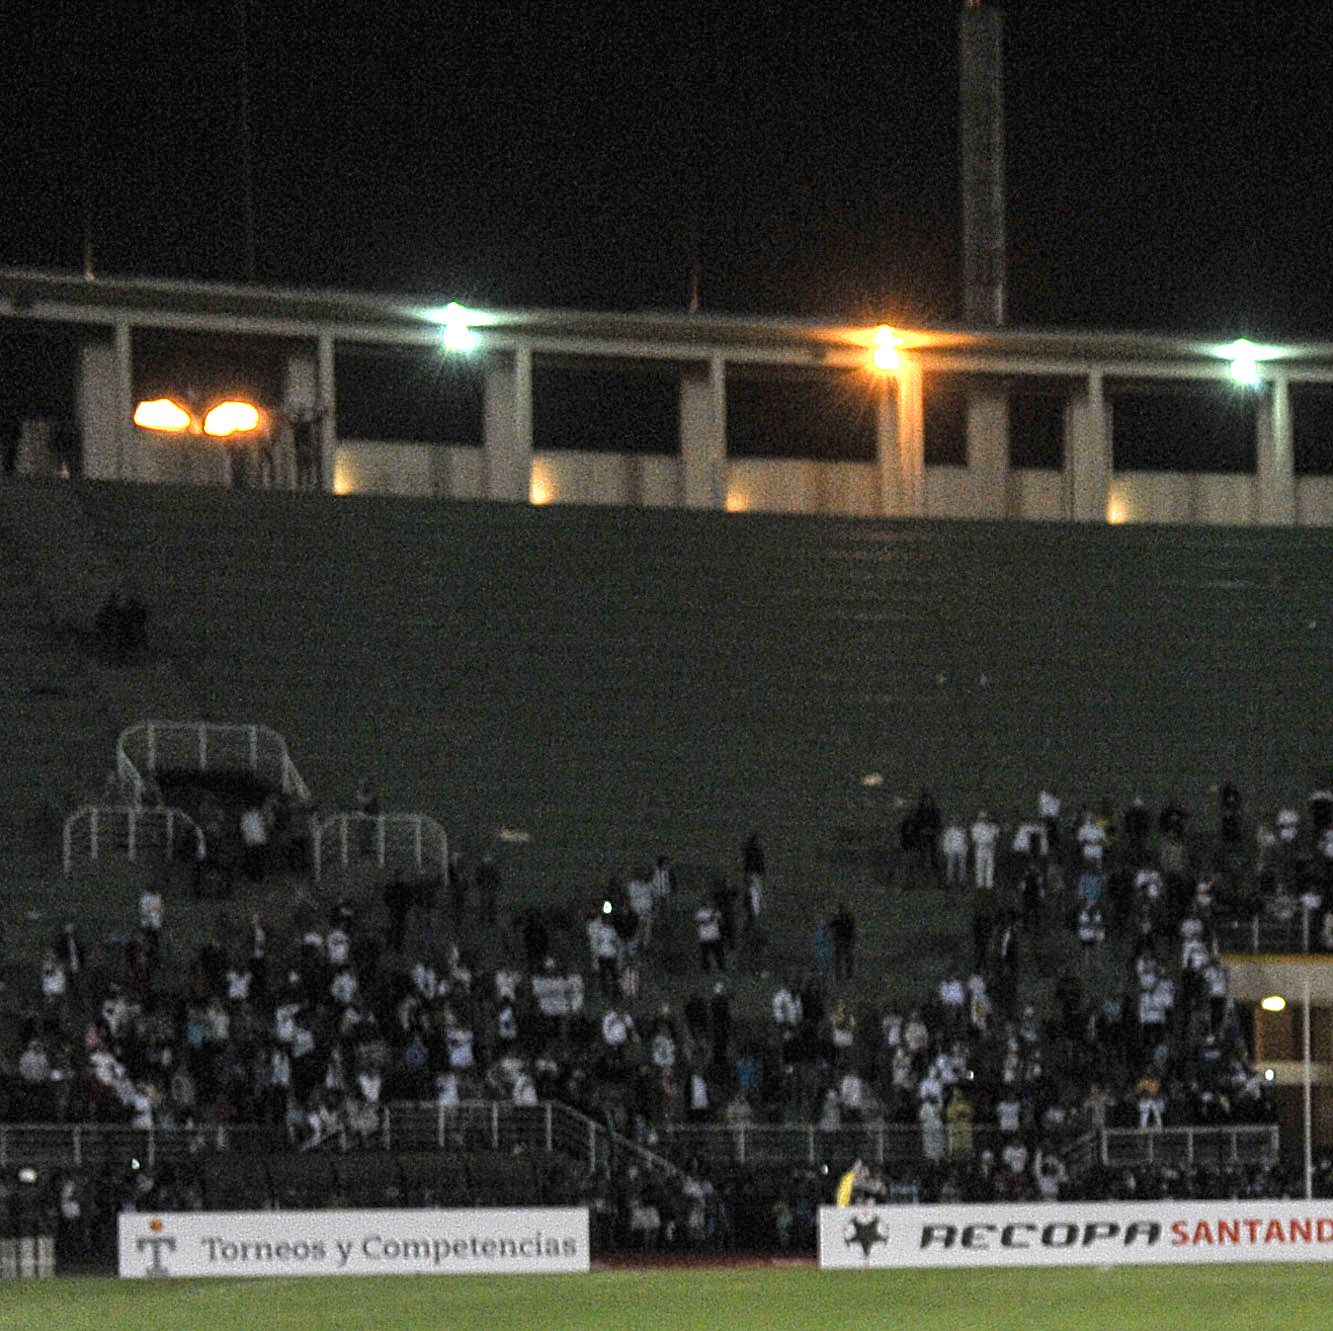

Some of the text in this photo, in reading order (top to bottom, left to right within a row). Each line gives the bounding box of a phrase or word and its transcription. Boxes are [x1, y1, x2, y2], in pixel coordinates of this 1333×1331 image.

[201, 1230, 578, 1267] Torneos y Competencias
[920, 1220, 1163, 1249] RECOPA
